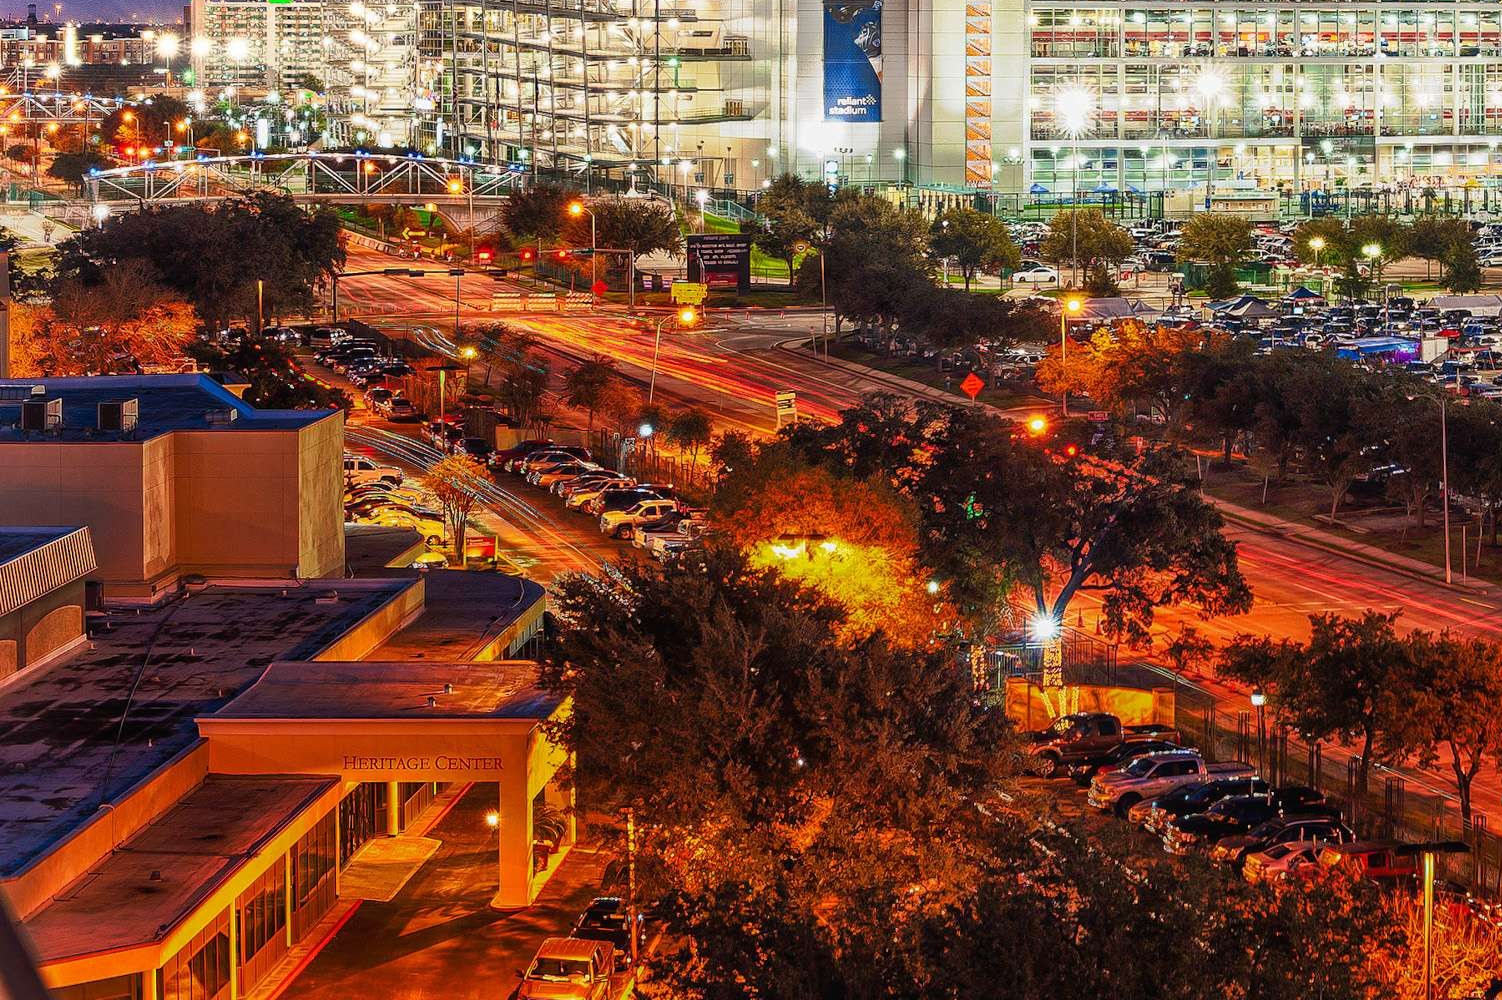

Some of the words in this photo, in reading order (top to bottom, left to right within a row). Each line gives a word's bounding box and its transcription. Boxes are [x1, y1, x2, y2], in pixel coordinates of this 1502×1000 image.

[837, 97, 866, 105] reliant
[829, 105, 867, 114] stadium
[343, 755, 430, 770] HERITAGE
[435, 755, 504, 770] CENTER
